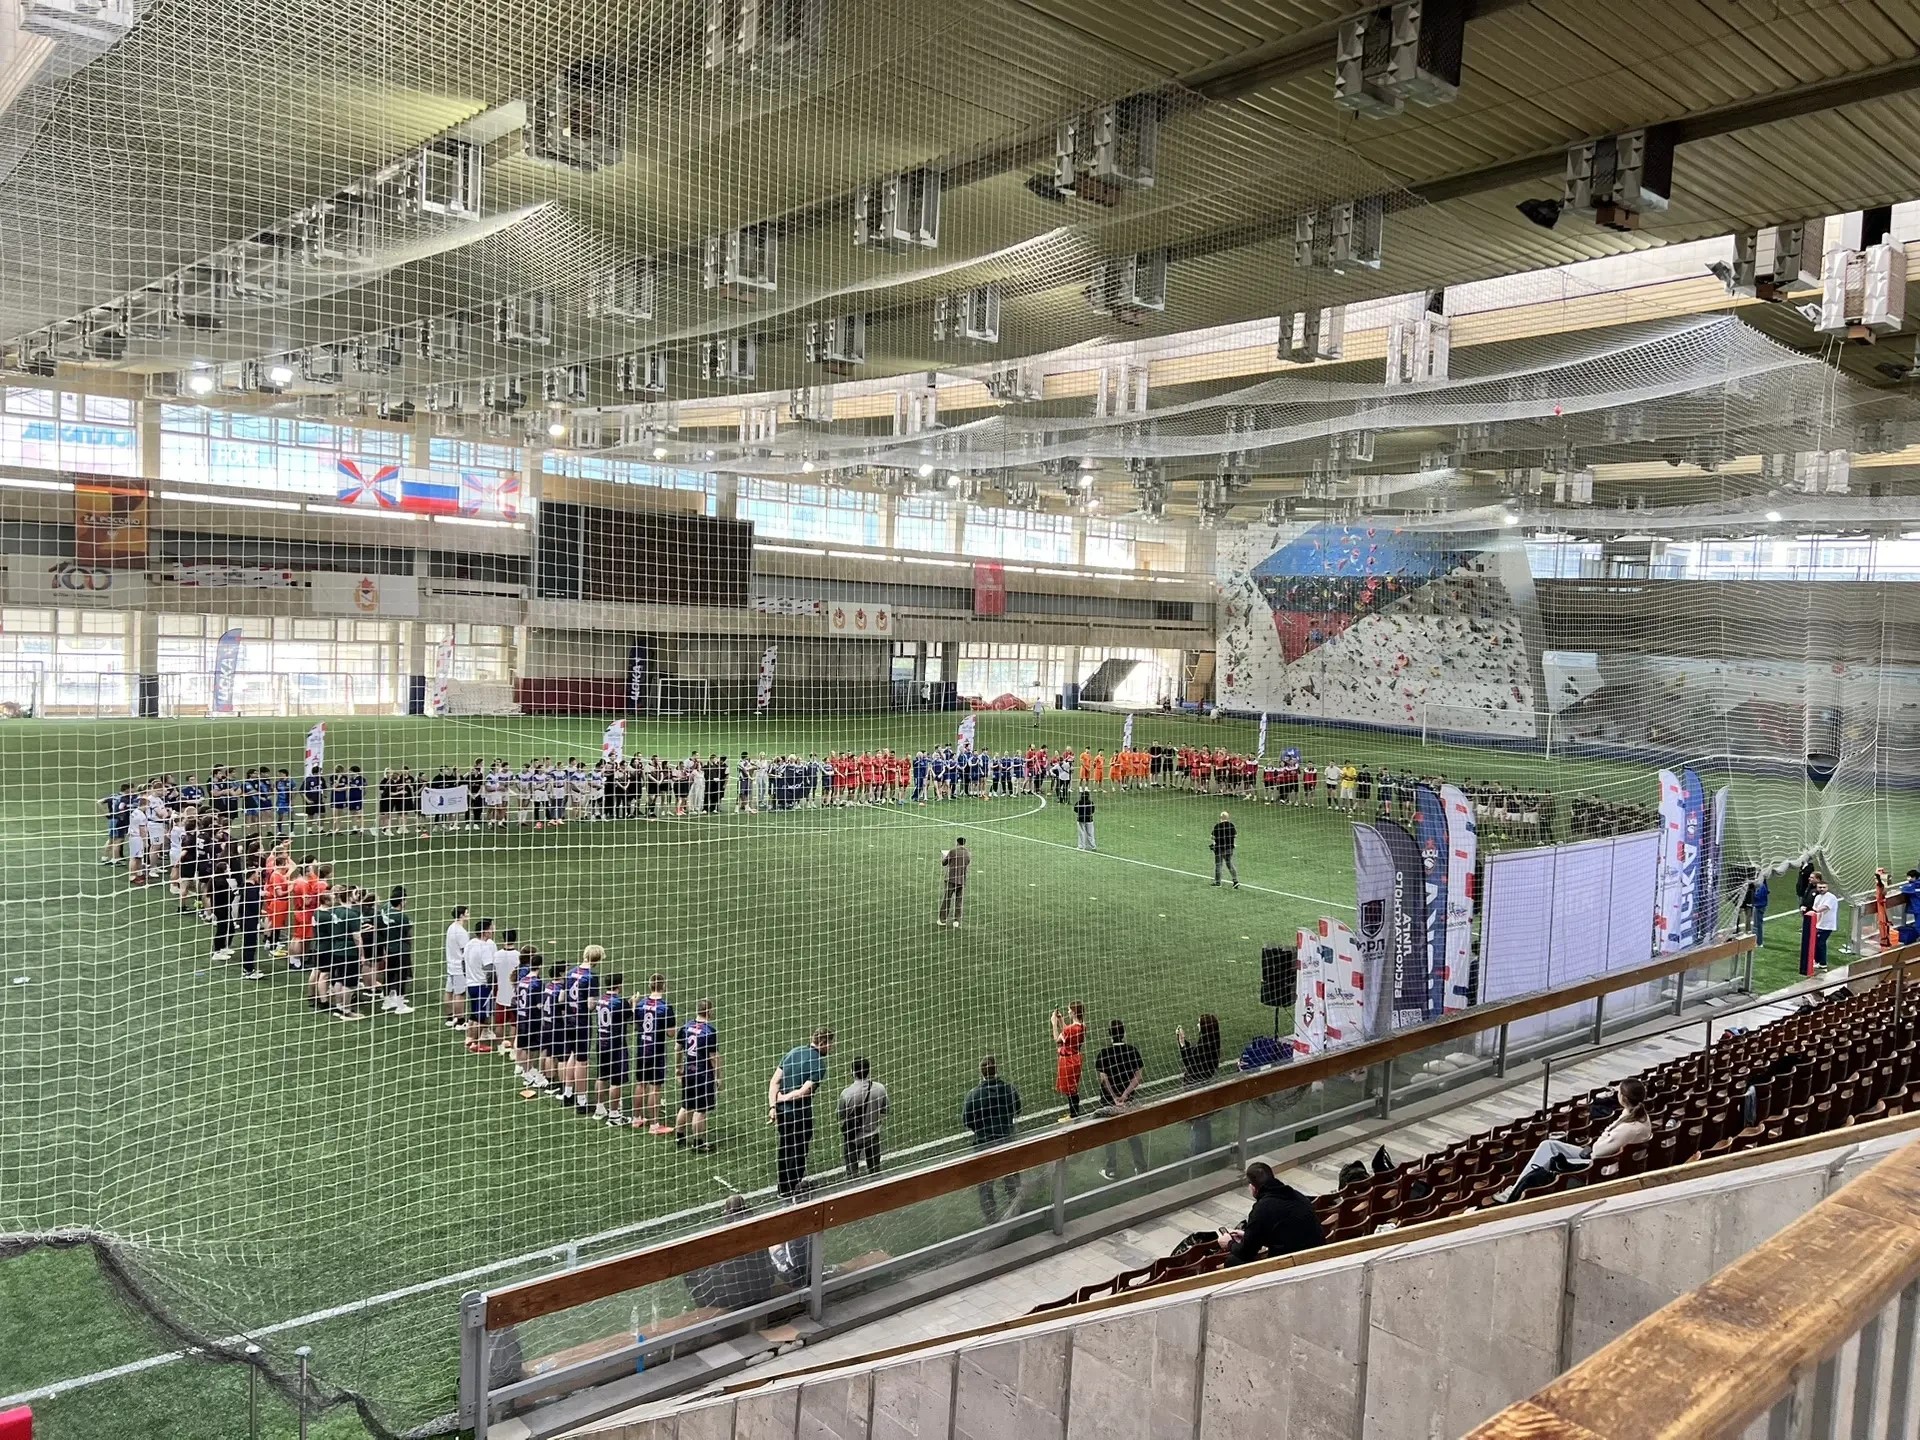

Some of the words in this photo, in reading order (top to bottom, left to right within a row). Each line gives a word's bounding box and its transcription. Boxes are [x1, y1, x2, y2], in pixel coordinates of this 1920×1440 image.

[596, 1005, 611, 1027] 10
[642, 1012, 654, 1033] 8
[687, 1034, 697, 1057] 2
